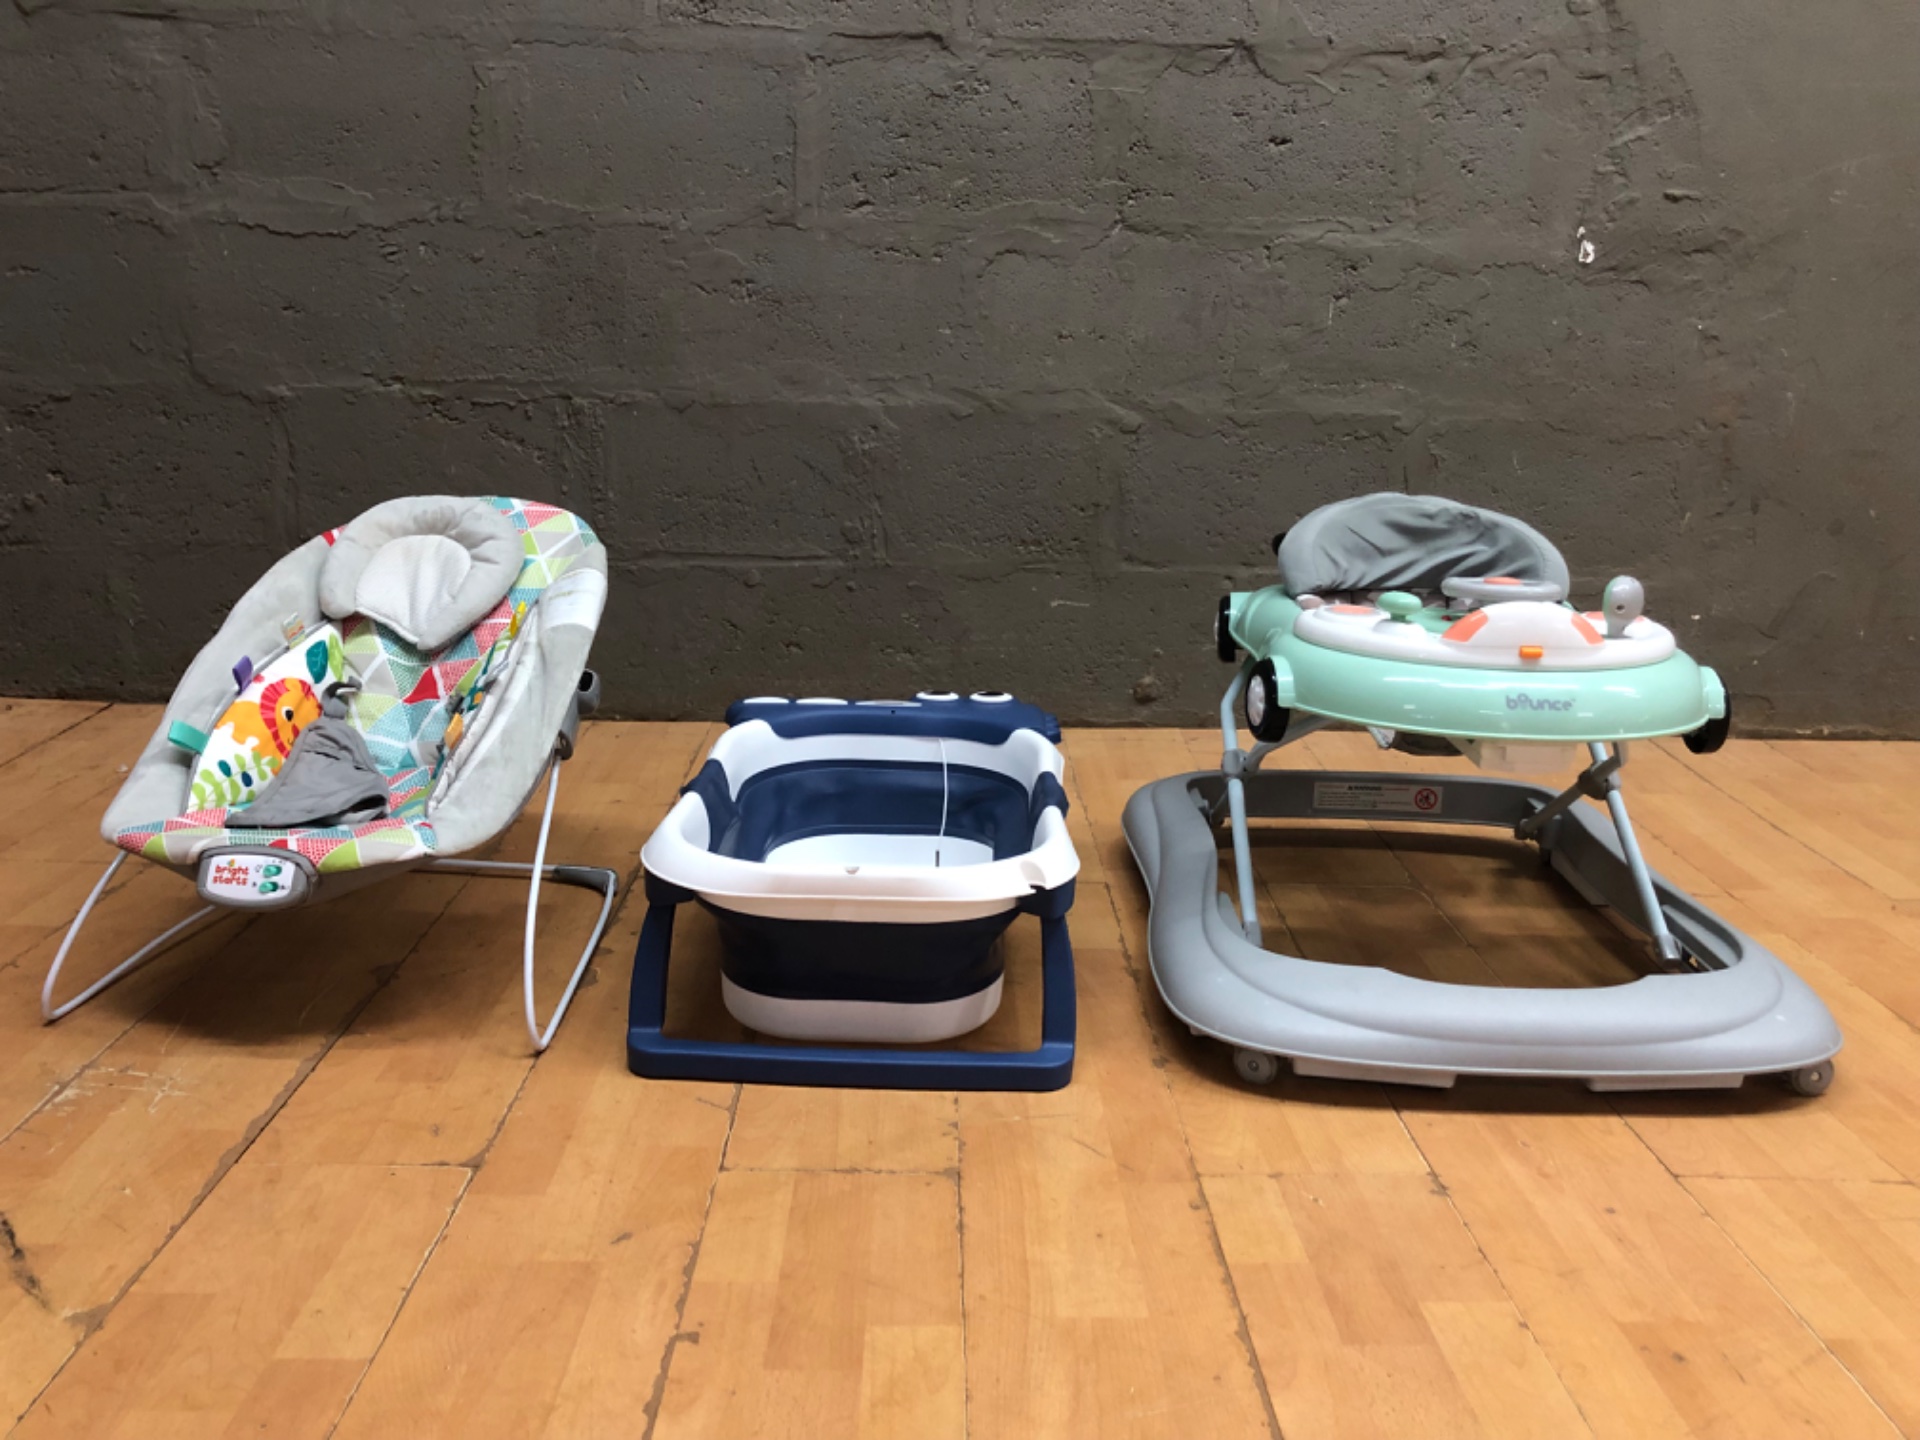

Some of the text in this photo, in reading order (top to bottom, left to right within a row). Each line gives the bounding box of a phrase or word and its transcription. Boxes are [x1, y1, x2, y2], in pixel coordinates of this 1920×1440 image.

[1506, 692, 1573, 711] bounce
[215, 863, 249, 877] bright
[212, 875, 248, 886] starts
